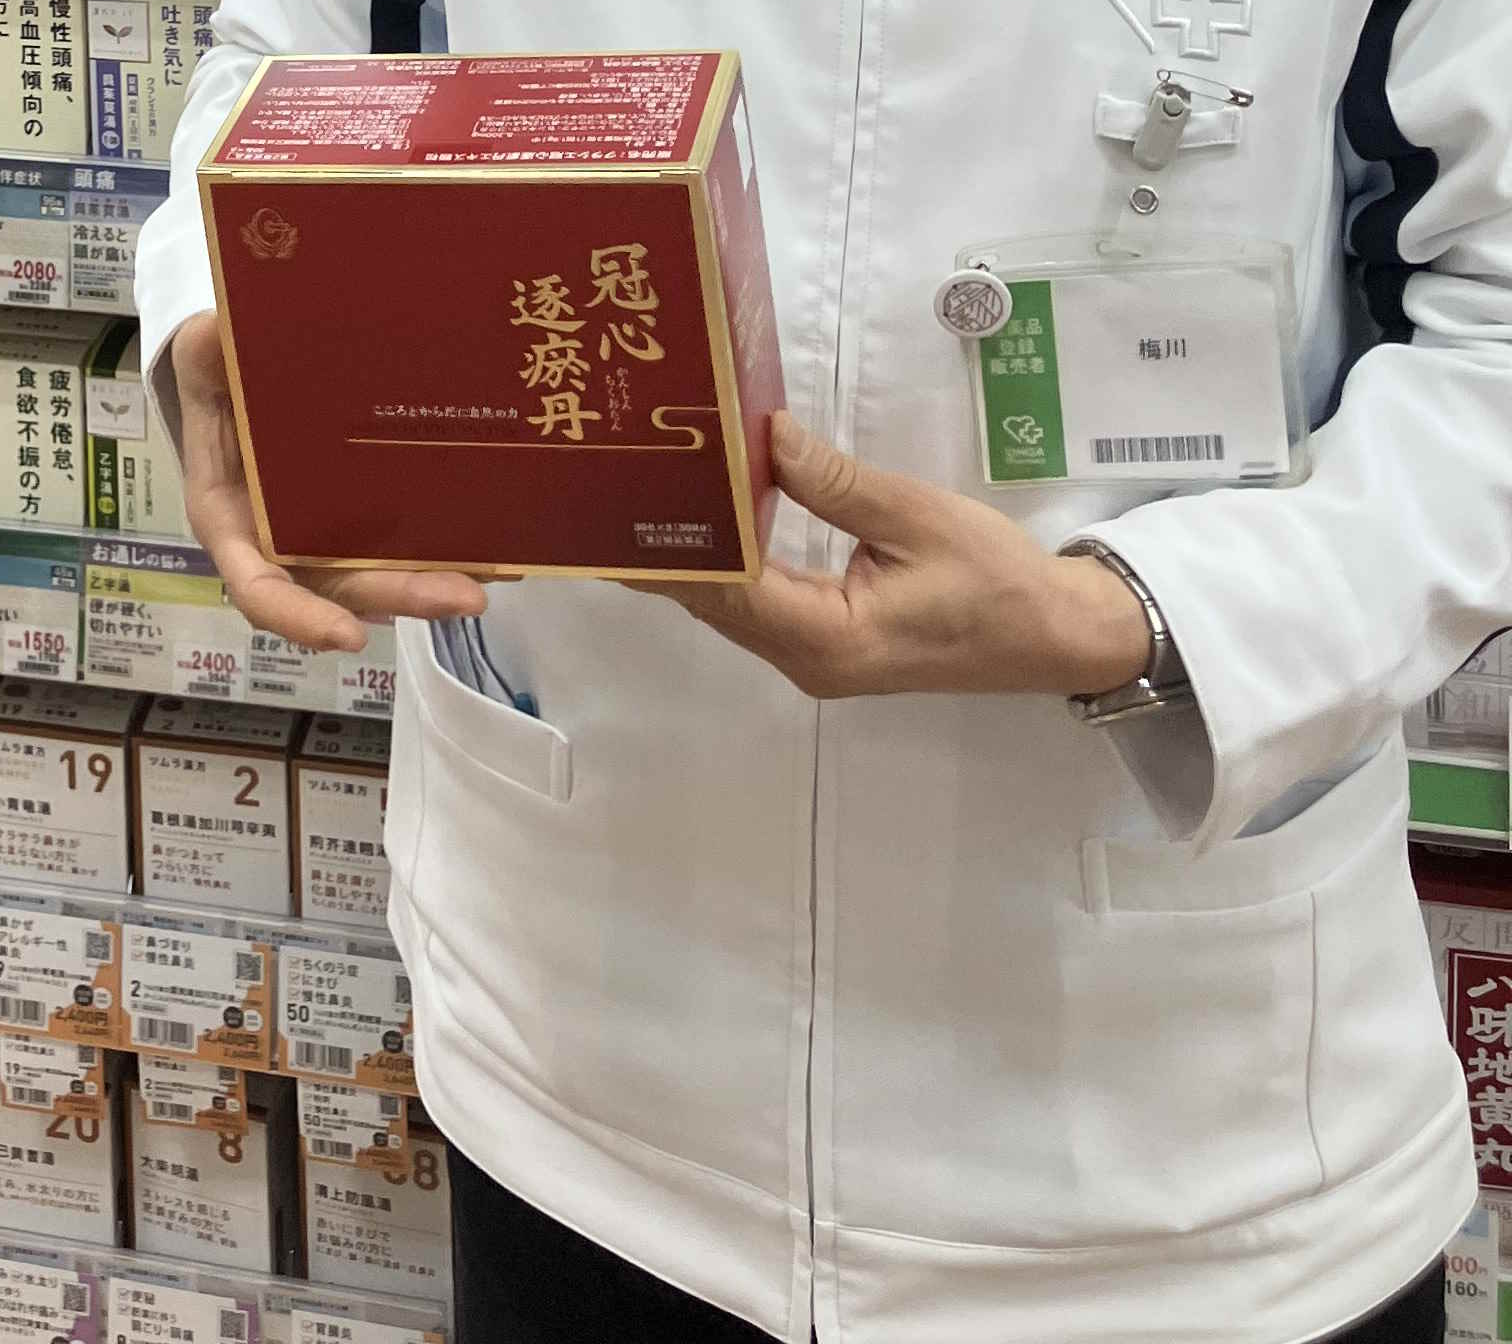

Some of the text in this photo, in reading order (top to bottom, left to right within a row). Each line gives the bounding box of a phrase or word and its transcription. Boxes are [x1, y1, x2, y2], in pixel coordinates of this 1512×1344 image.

[161, 5, 183, 86] 吐き気に
[60, 751, 112, 792] 19
[234, 767, 260, 806] 2
